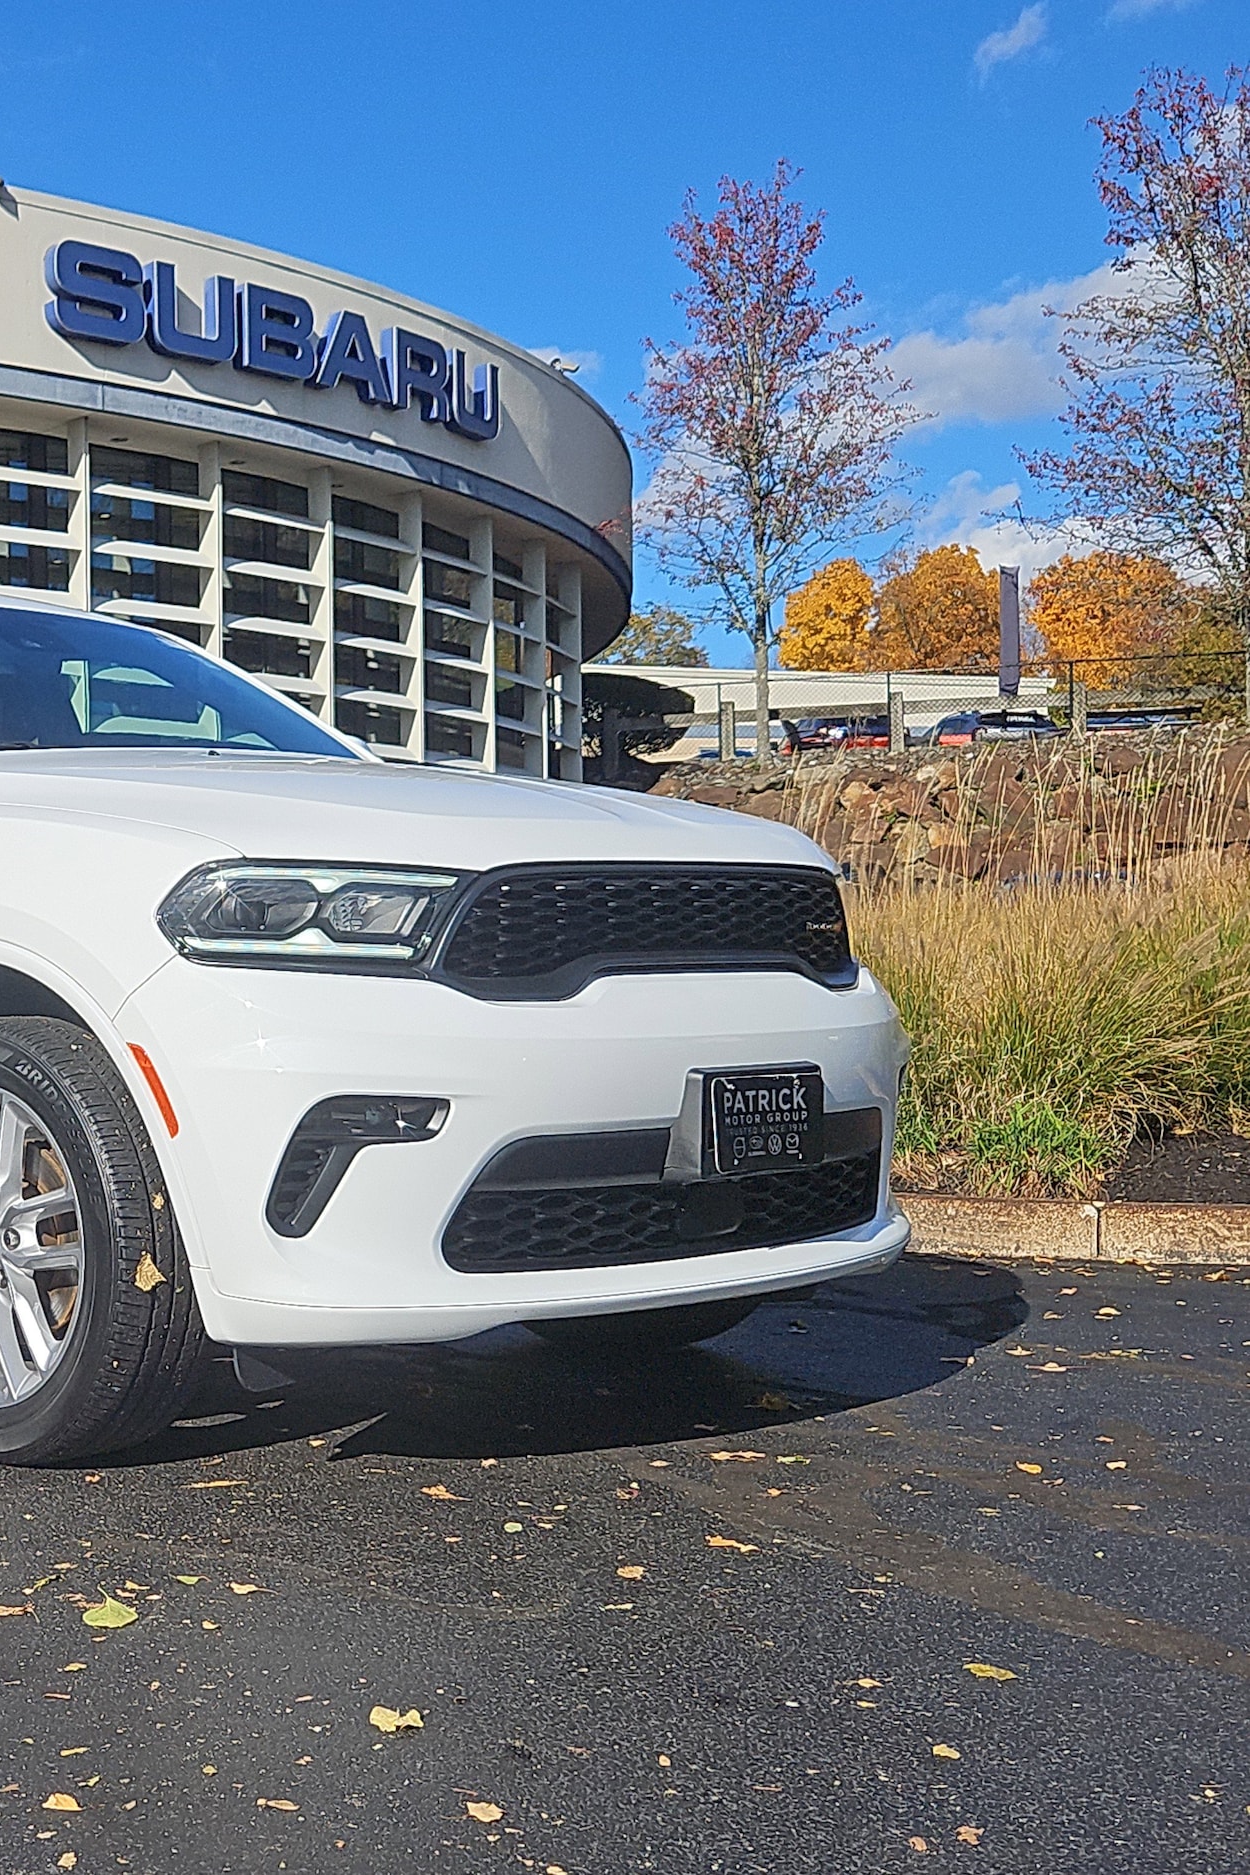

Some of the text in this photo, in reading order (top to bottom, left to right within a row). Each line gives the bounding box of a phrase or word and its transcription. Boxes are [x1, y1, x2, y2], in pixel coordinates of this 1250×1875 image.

[45, 239, 502, 442] SUBARU
[723, 1087, 808, 1114] PATRICK
[724, 1111, 808, 1126] MOTOR GROUP
[761, 1124, 786, 1134] SINCE
